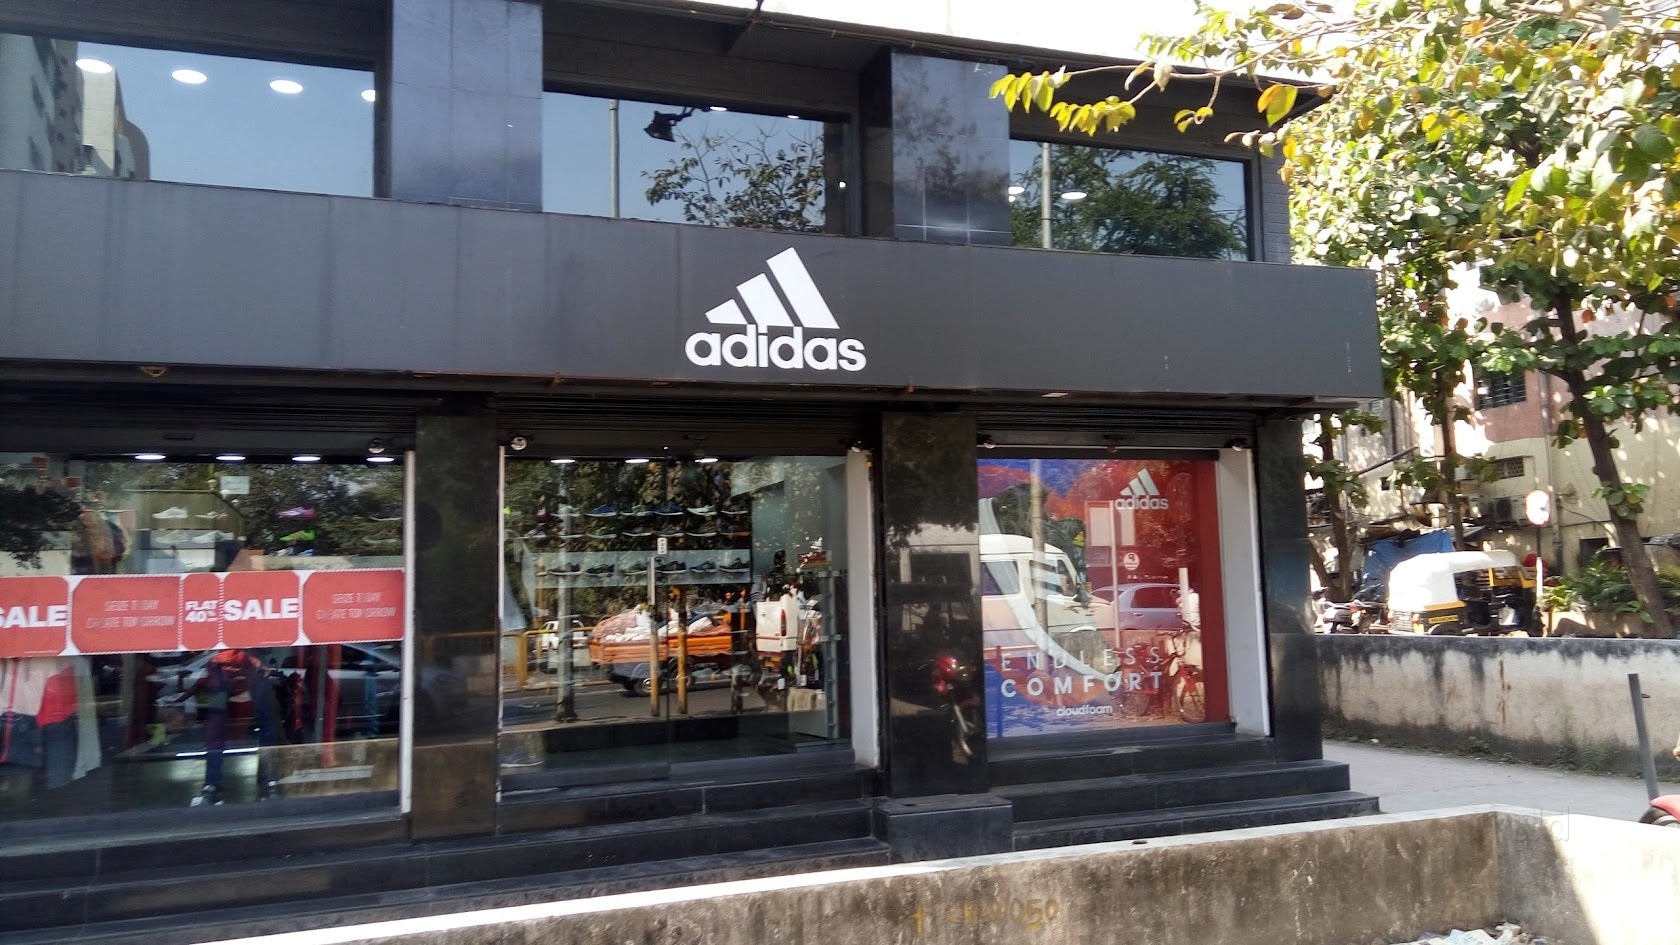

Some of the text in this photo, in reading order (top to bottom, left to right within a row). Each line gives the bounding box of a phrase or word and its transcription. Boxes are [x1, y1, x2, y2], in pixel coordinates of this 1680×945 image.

[685, 324, 867, 372] adidas
[1114, 494, 1169, 510] adidas
[184, 599, 219, 611] FLAT
[223, 597, 299, 621] SALE
[1001, 647, 1160, 672] ENDLESS
[1002, 671, 1162, 698] COMFORT
[1056, 703, 1113, 717] cloudfoam
